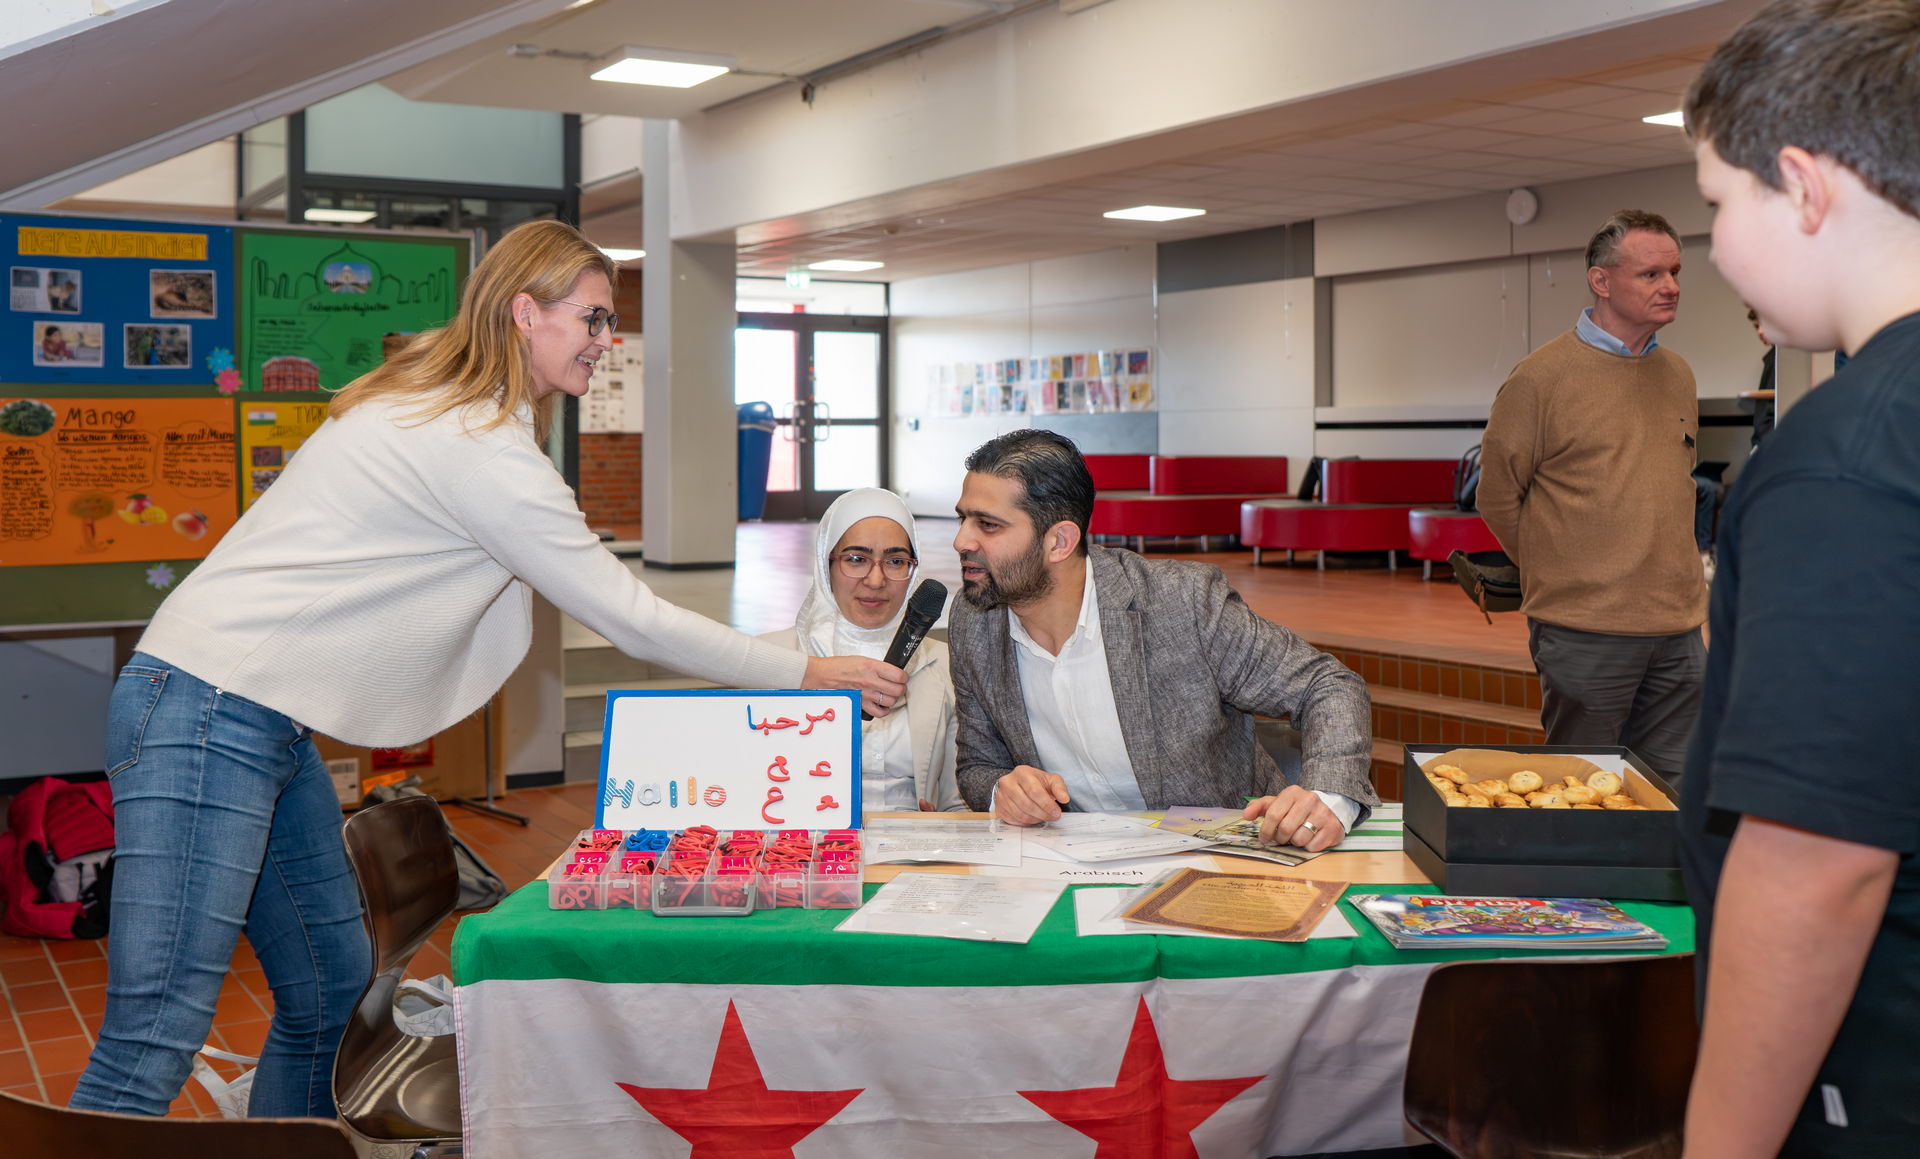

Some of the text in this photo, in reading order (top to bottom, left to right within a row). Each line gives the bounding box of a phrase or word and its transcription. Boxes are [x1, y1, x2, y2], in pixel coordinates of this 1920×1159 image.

[63, 407, 136, 428] Mango
[747, 703, 836, 735] مرحبا
[603, 776, 727, 808] Hallo
